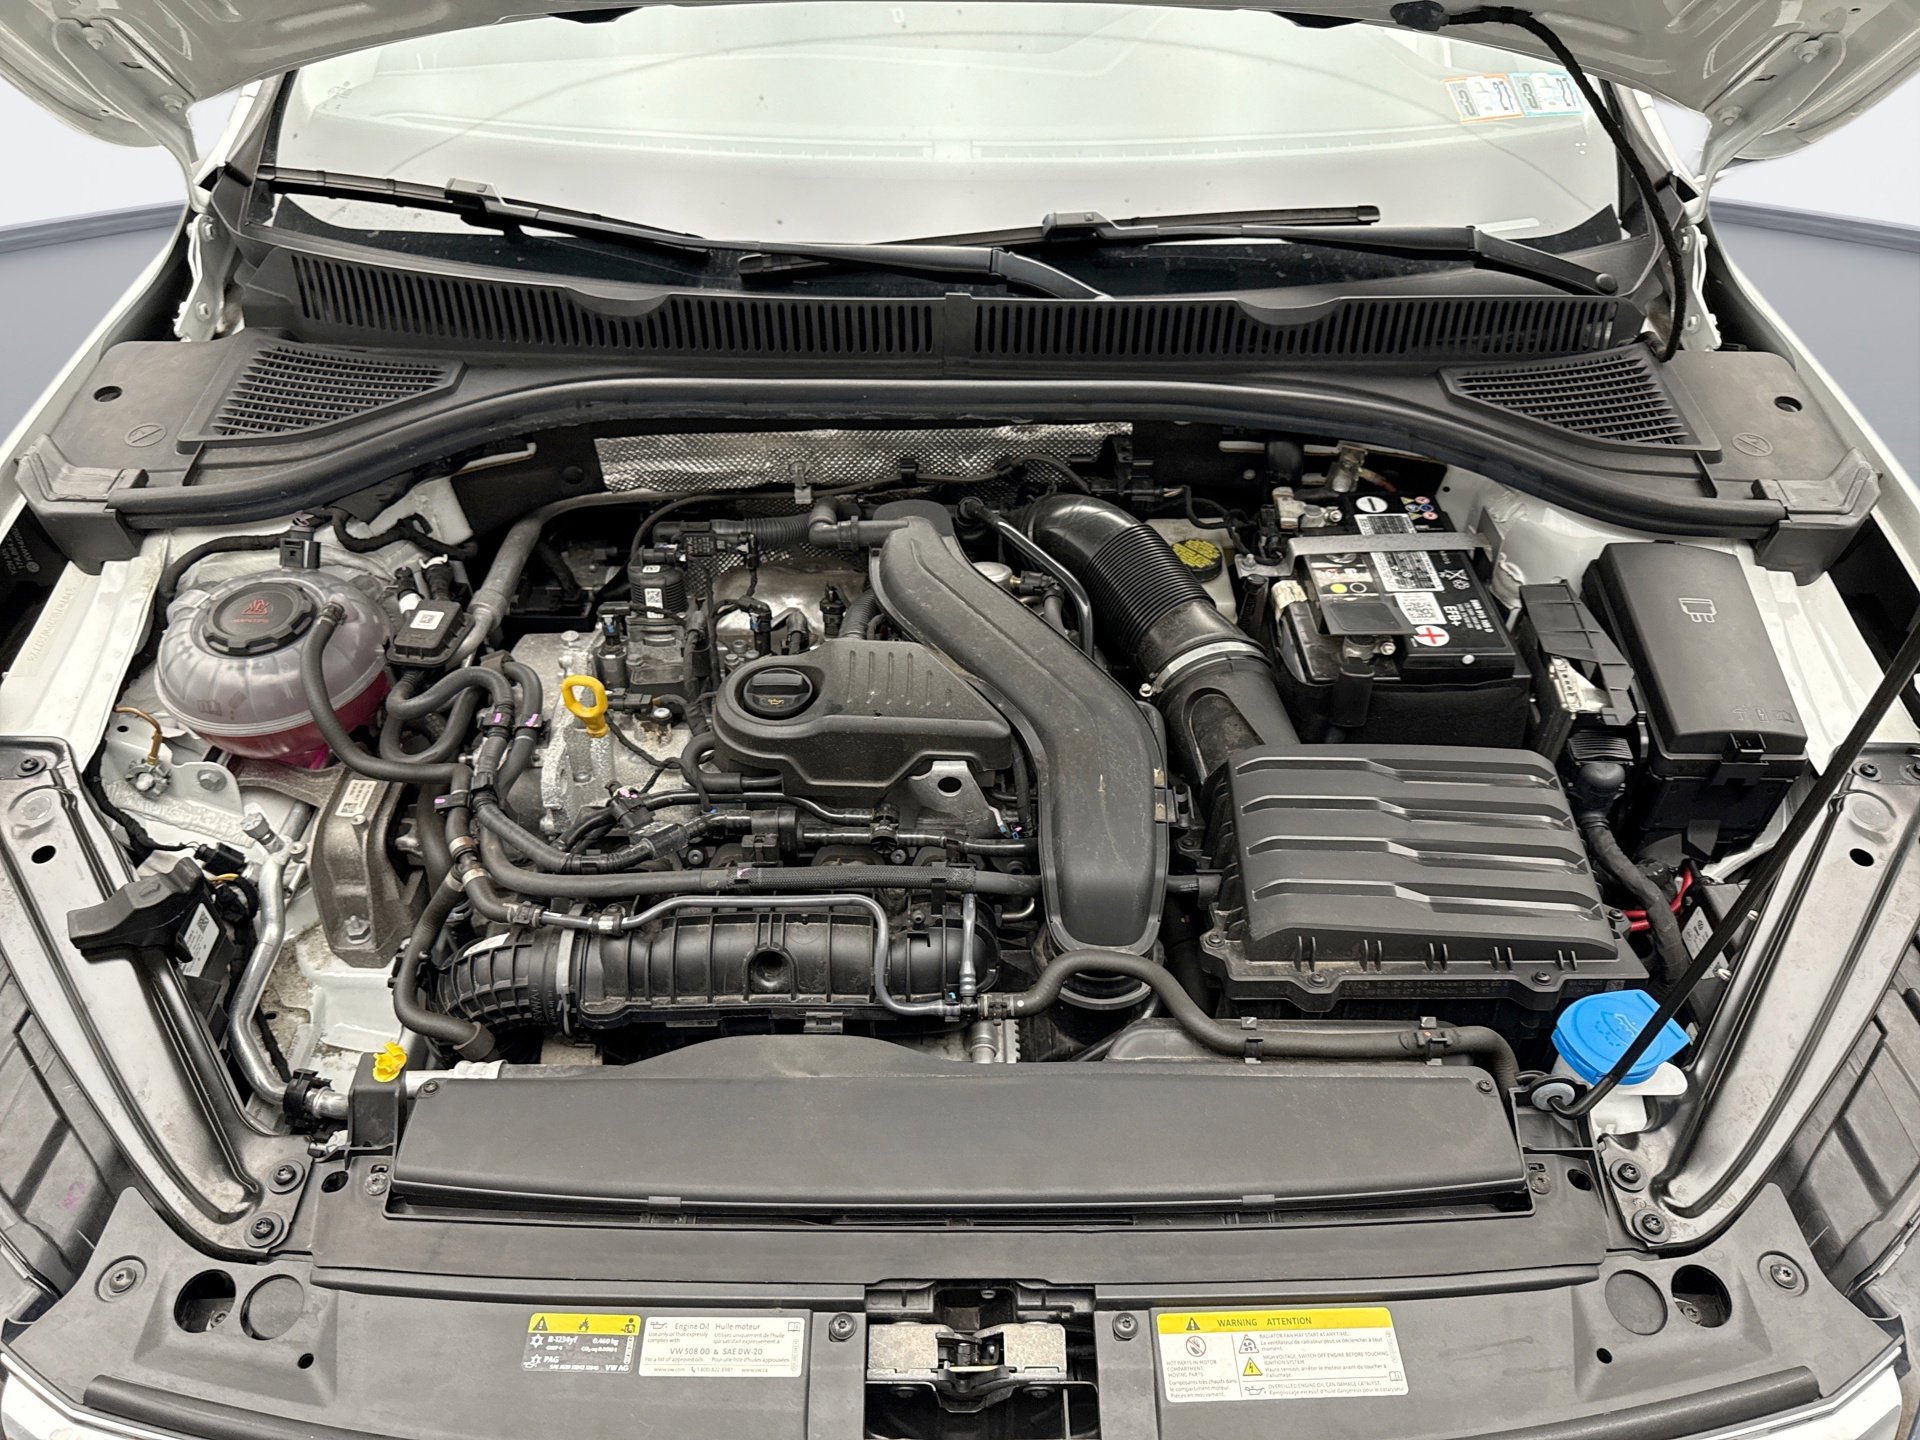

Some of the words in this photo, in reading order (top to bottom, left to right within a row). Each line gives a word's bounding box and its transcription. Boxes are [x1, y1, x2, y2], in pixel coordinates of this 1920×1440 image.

[1442, 605, 1464, 626] EFB+
[1217, 1319, 1257, 1327] WARNING
[1267, 1317, 1312, 1325] ATTENTION
[675, 1323, 697, 1331] Engine
[700, 1322, 709, 1330] Oil
